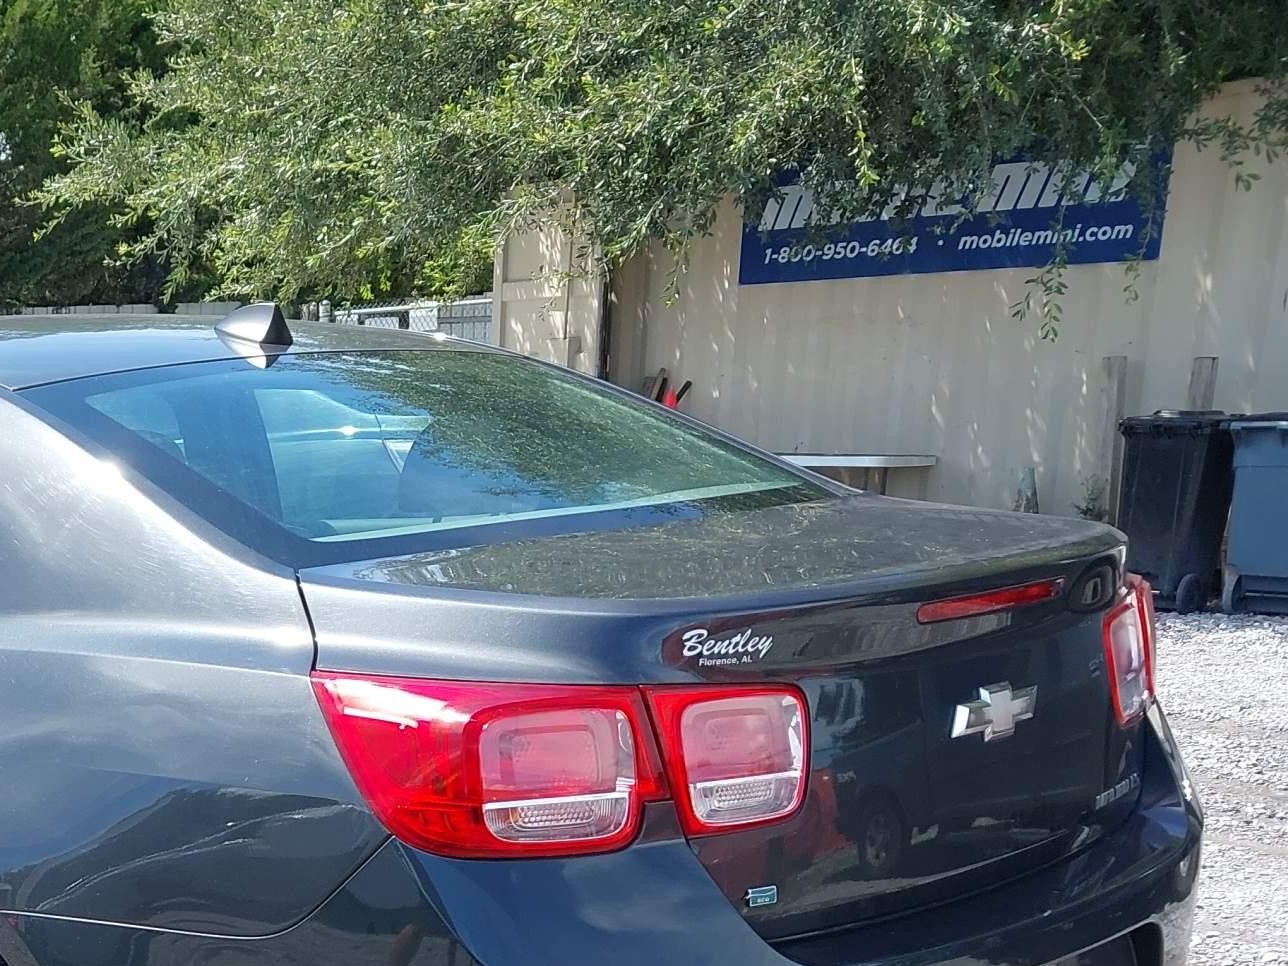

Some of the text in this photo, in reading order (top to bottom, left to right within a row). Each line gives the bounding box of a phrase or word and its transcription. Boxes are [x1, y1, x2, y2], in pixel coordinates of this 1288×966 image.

[682, 628, 773, 658] Bentley
[699, 655, 753, 667] Florence, AL
